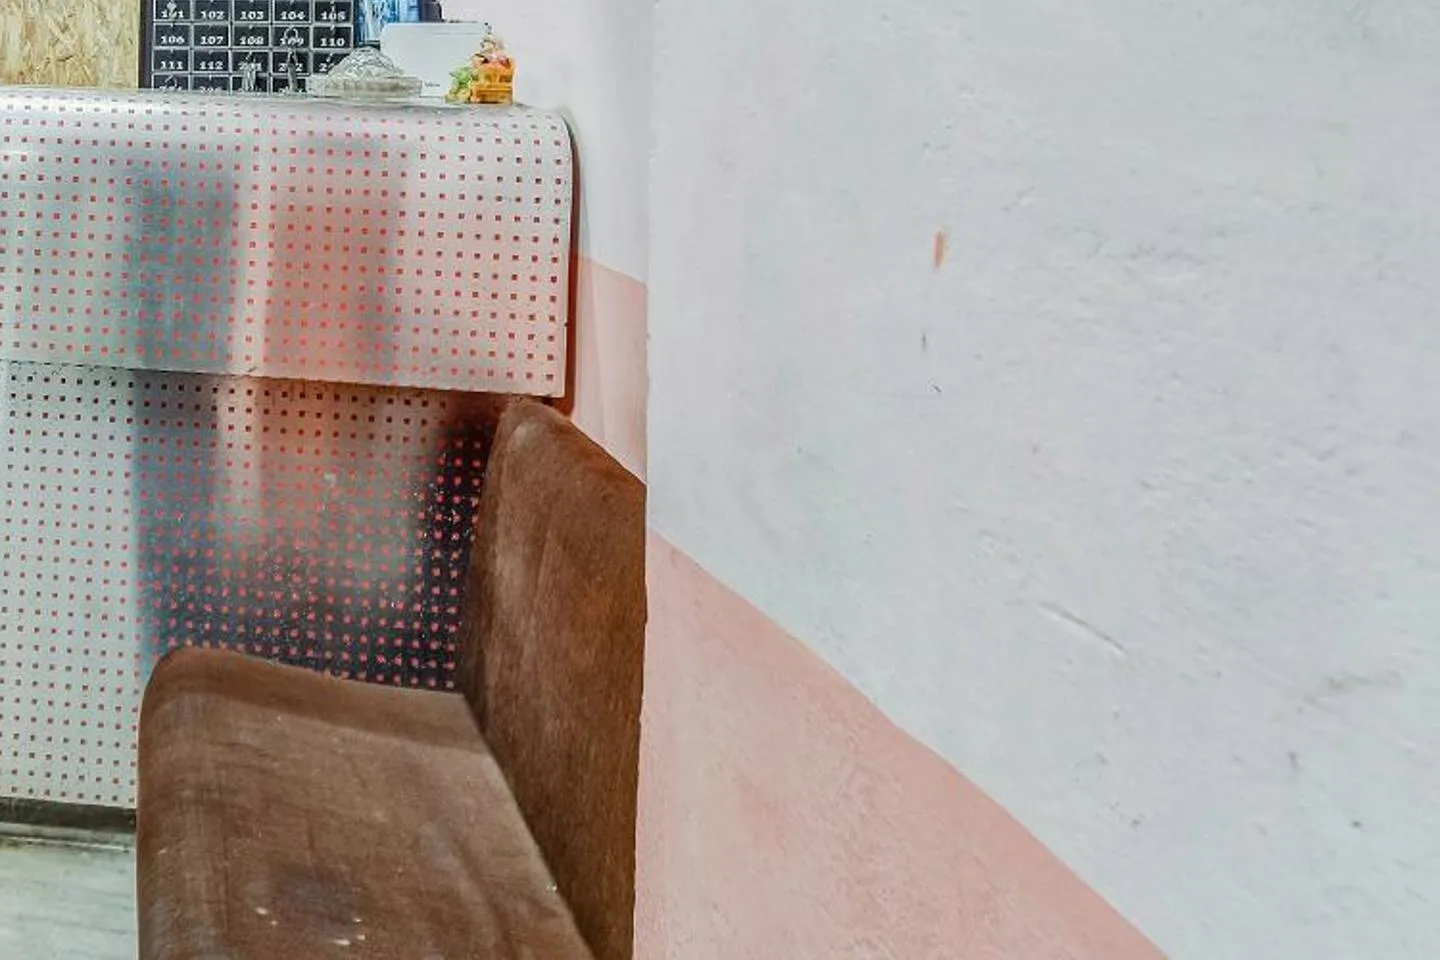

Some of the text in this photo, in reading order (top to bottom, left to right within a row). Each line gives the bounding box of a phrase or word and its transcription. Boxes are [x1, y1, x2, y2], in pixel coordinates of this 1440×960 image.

[200, 9, 226, 20] 102
[239, 10, 265, 20] 103
[279, 10, 305, 20] 104
[160, 35, 185, 45] 106
[200, 35, 224, 45] 107
[320, 36, 346, 47] 110
[160, 60, 183, 70] 111
[199, 60, 224, 70] 112
